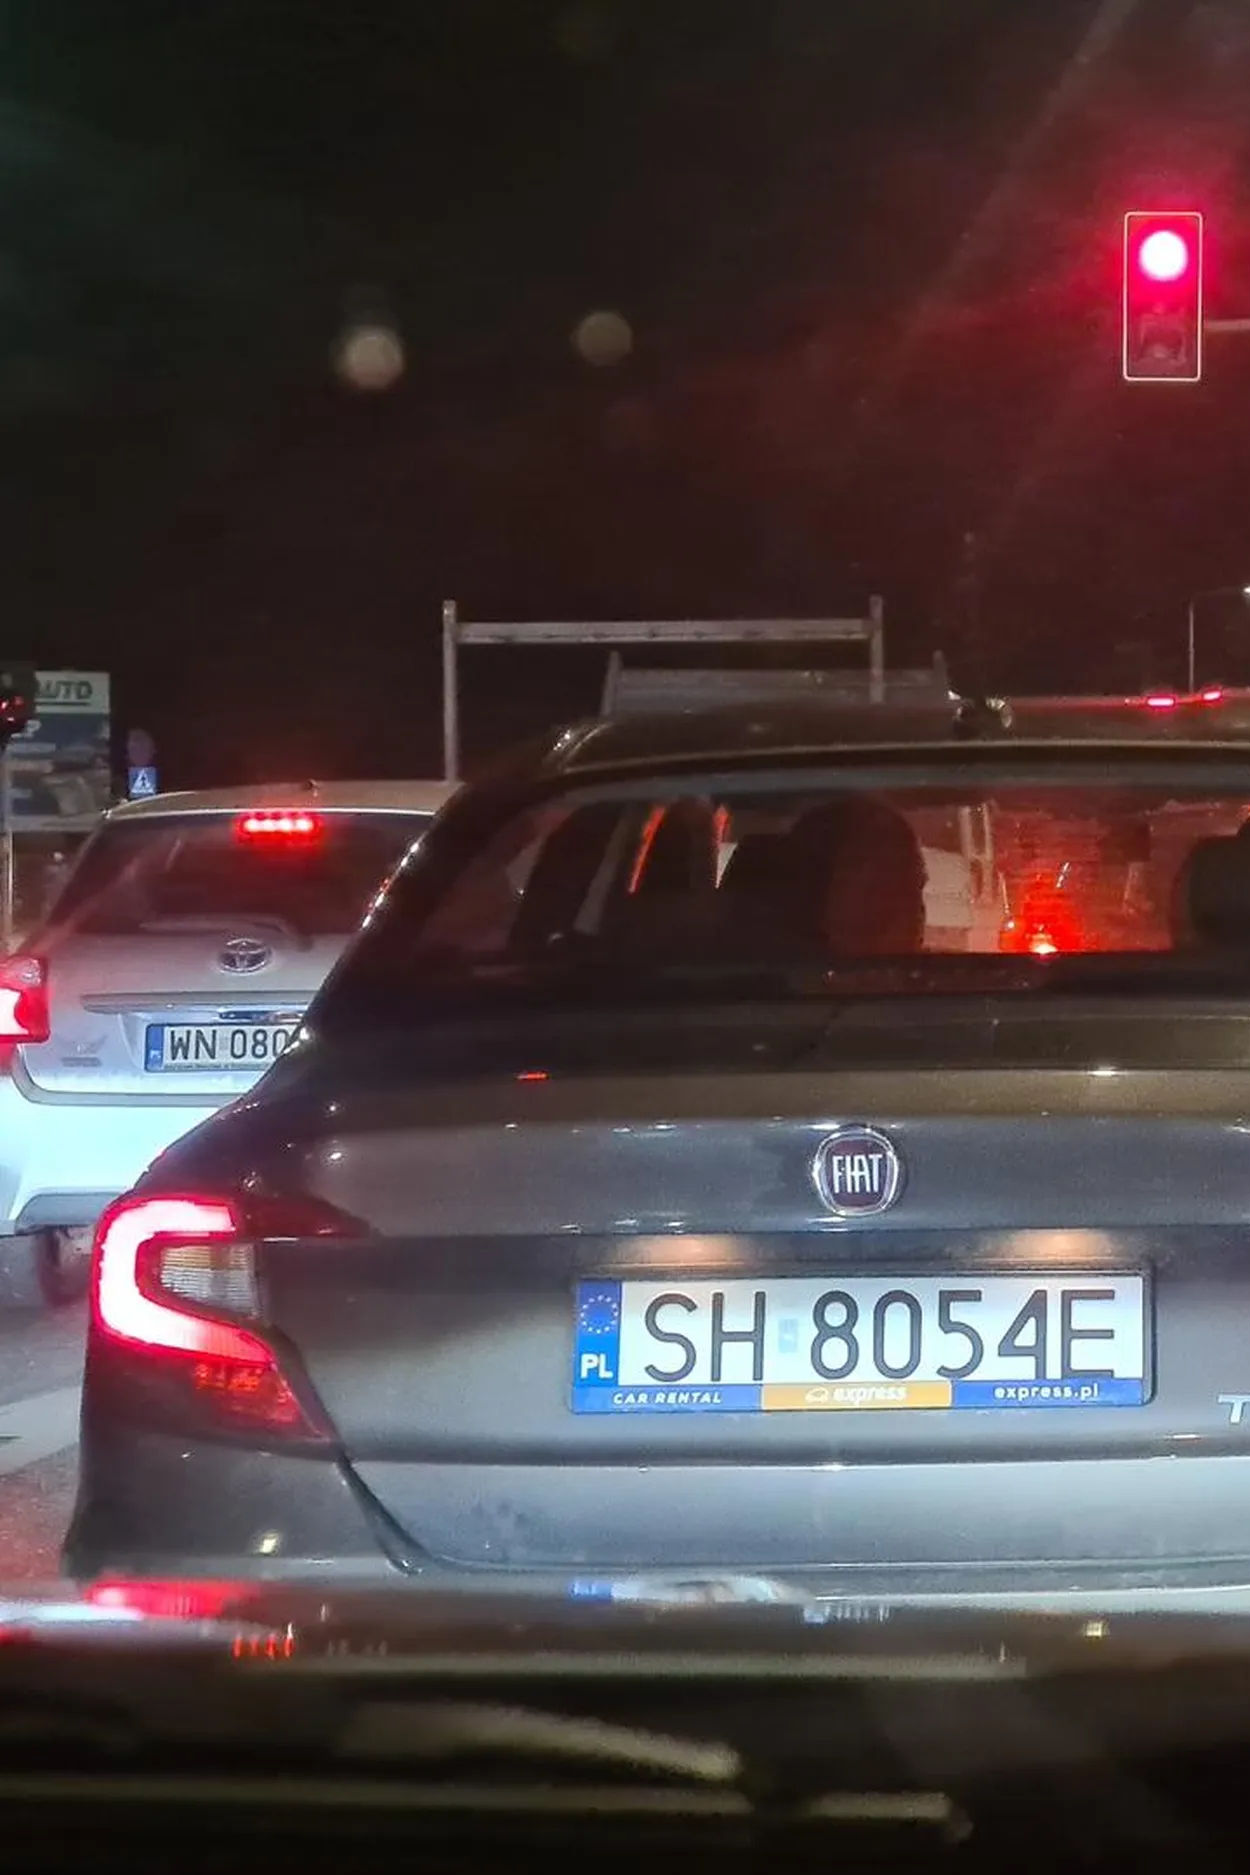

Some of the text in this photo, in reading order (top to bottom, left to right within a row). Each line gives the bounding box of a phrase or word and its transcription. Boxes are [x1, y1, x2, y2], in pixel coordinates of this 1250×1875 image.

[170, 1029, 217, 1061] WN
[832, 1154, 883, 1194] FIAT
[645, 1289, 1116, 1382] SH 8054E
[580, 1353, 613, 1379] PL
[613, 1391, 722, 1405] CAR RENTAL
[833, 1386, 908, 1404] express
[994, 1383, 1099, 1400] express.pl
